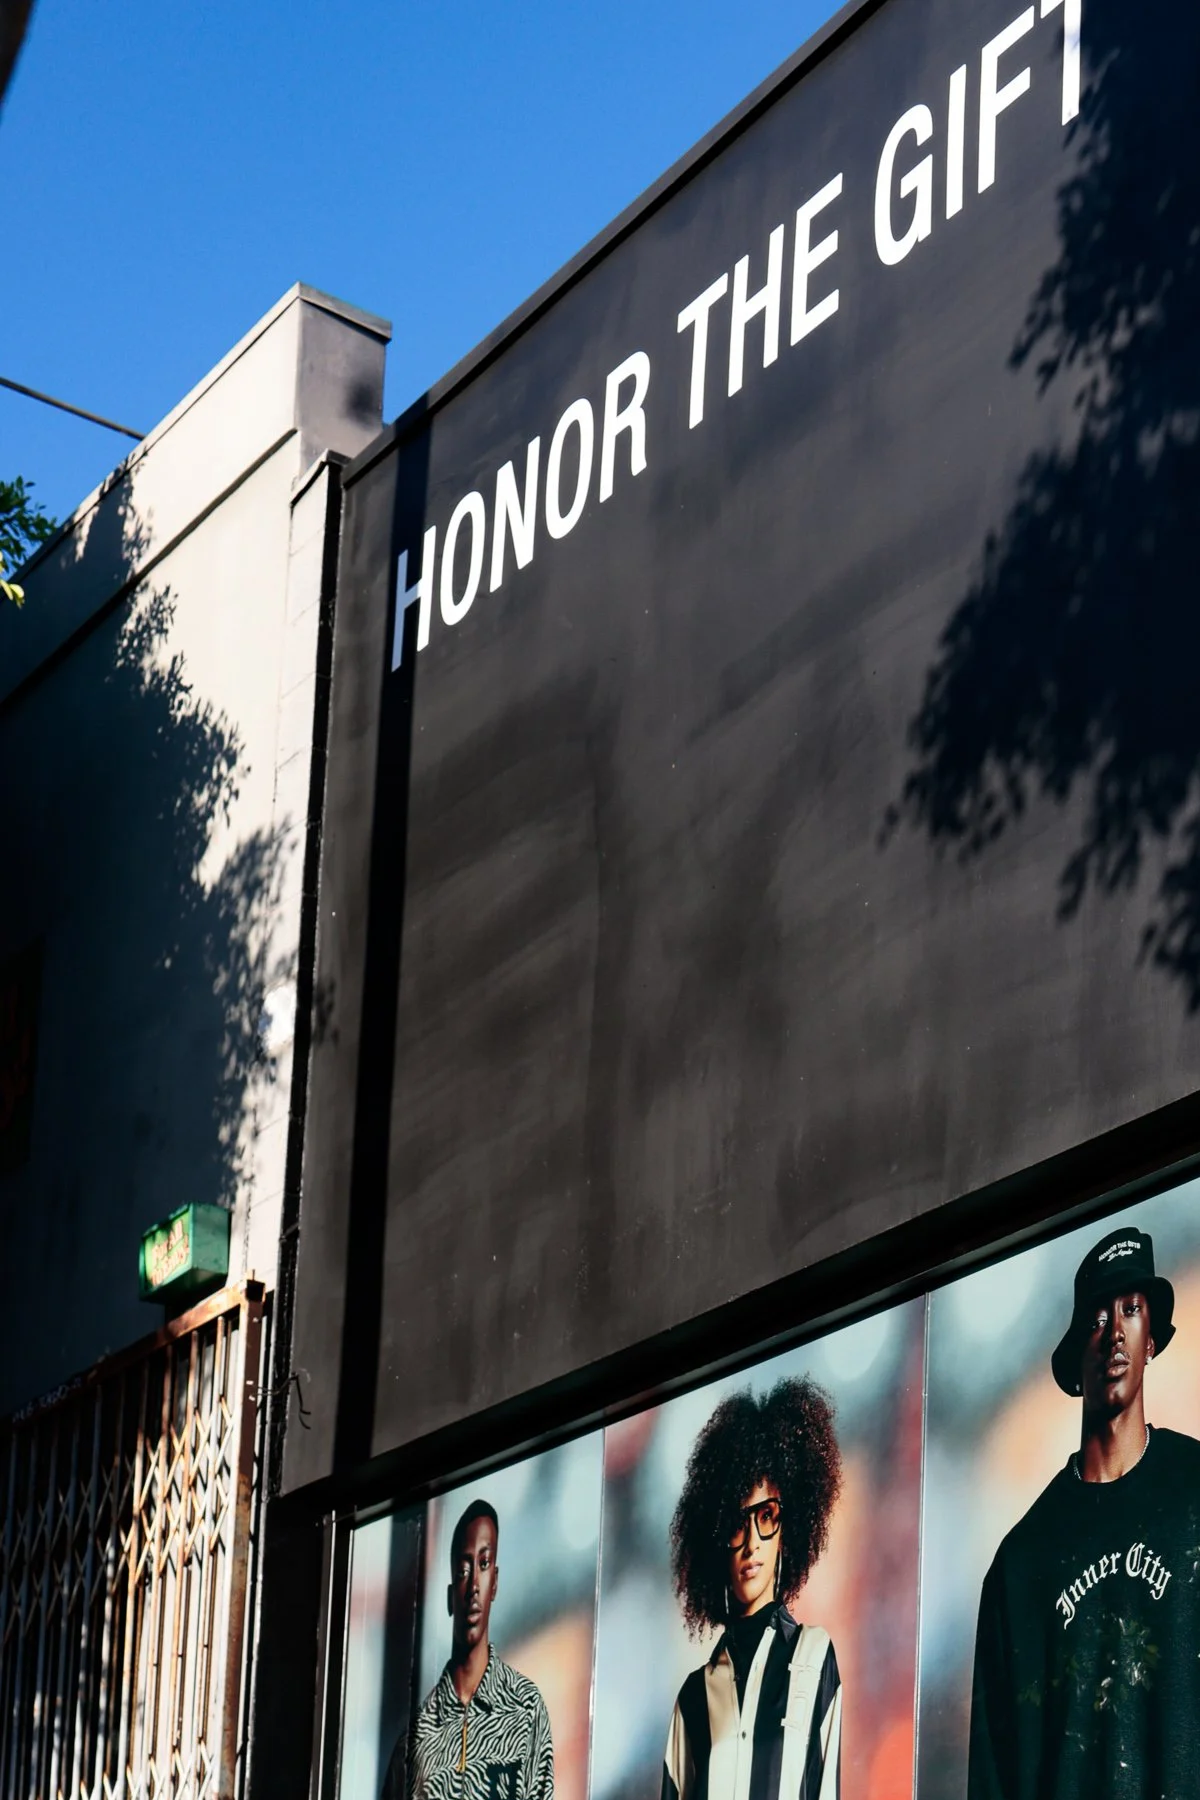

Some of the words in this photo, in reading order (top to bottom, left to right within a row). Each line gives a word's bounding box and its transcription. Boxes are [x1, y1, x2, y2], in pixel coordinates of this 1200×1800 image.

[391, 350, 649, 672] HONOR
[677, 172, 844, 429] THE
[874, 0, 1083, 266] GIFT
[1055, 1552, 1121, 1630] Inner
[1125, 1542, 1172, 1600] City
